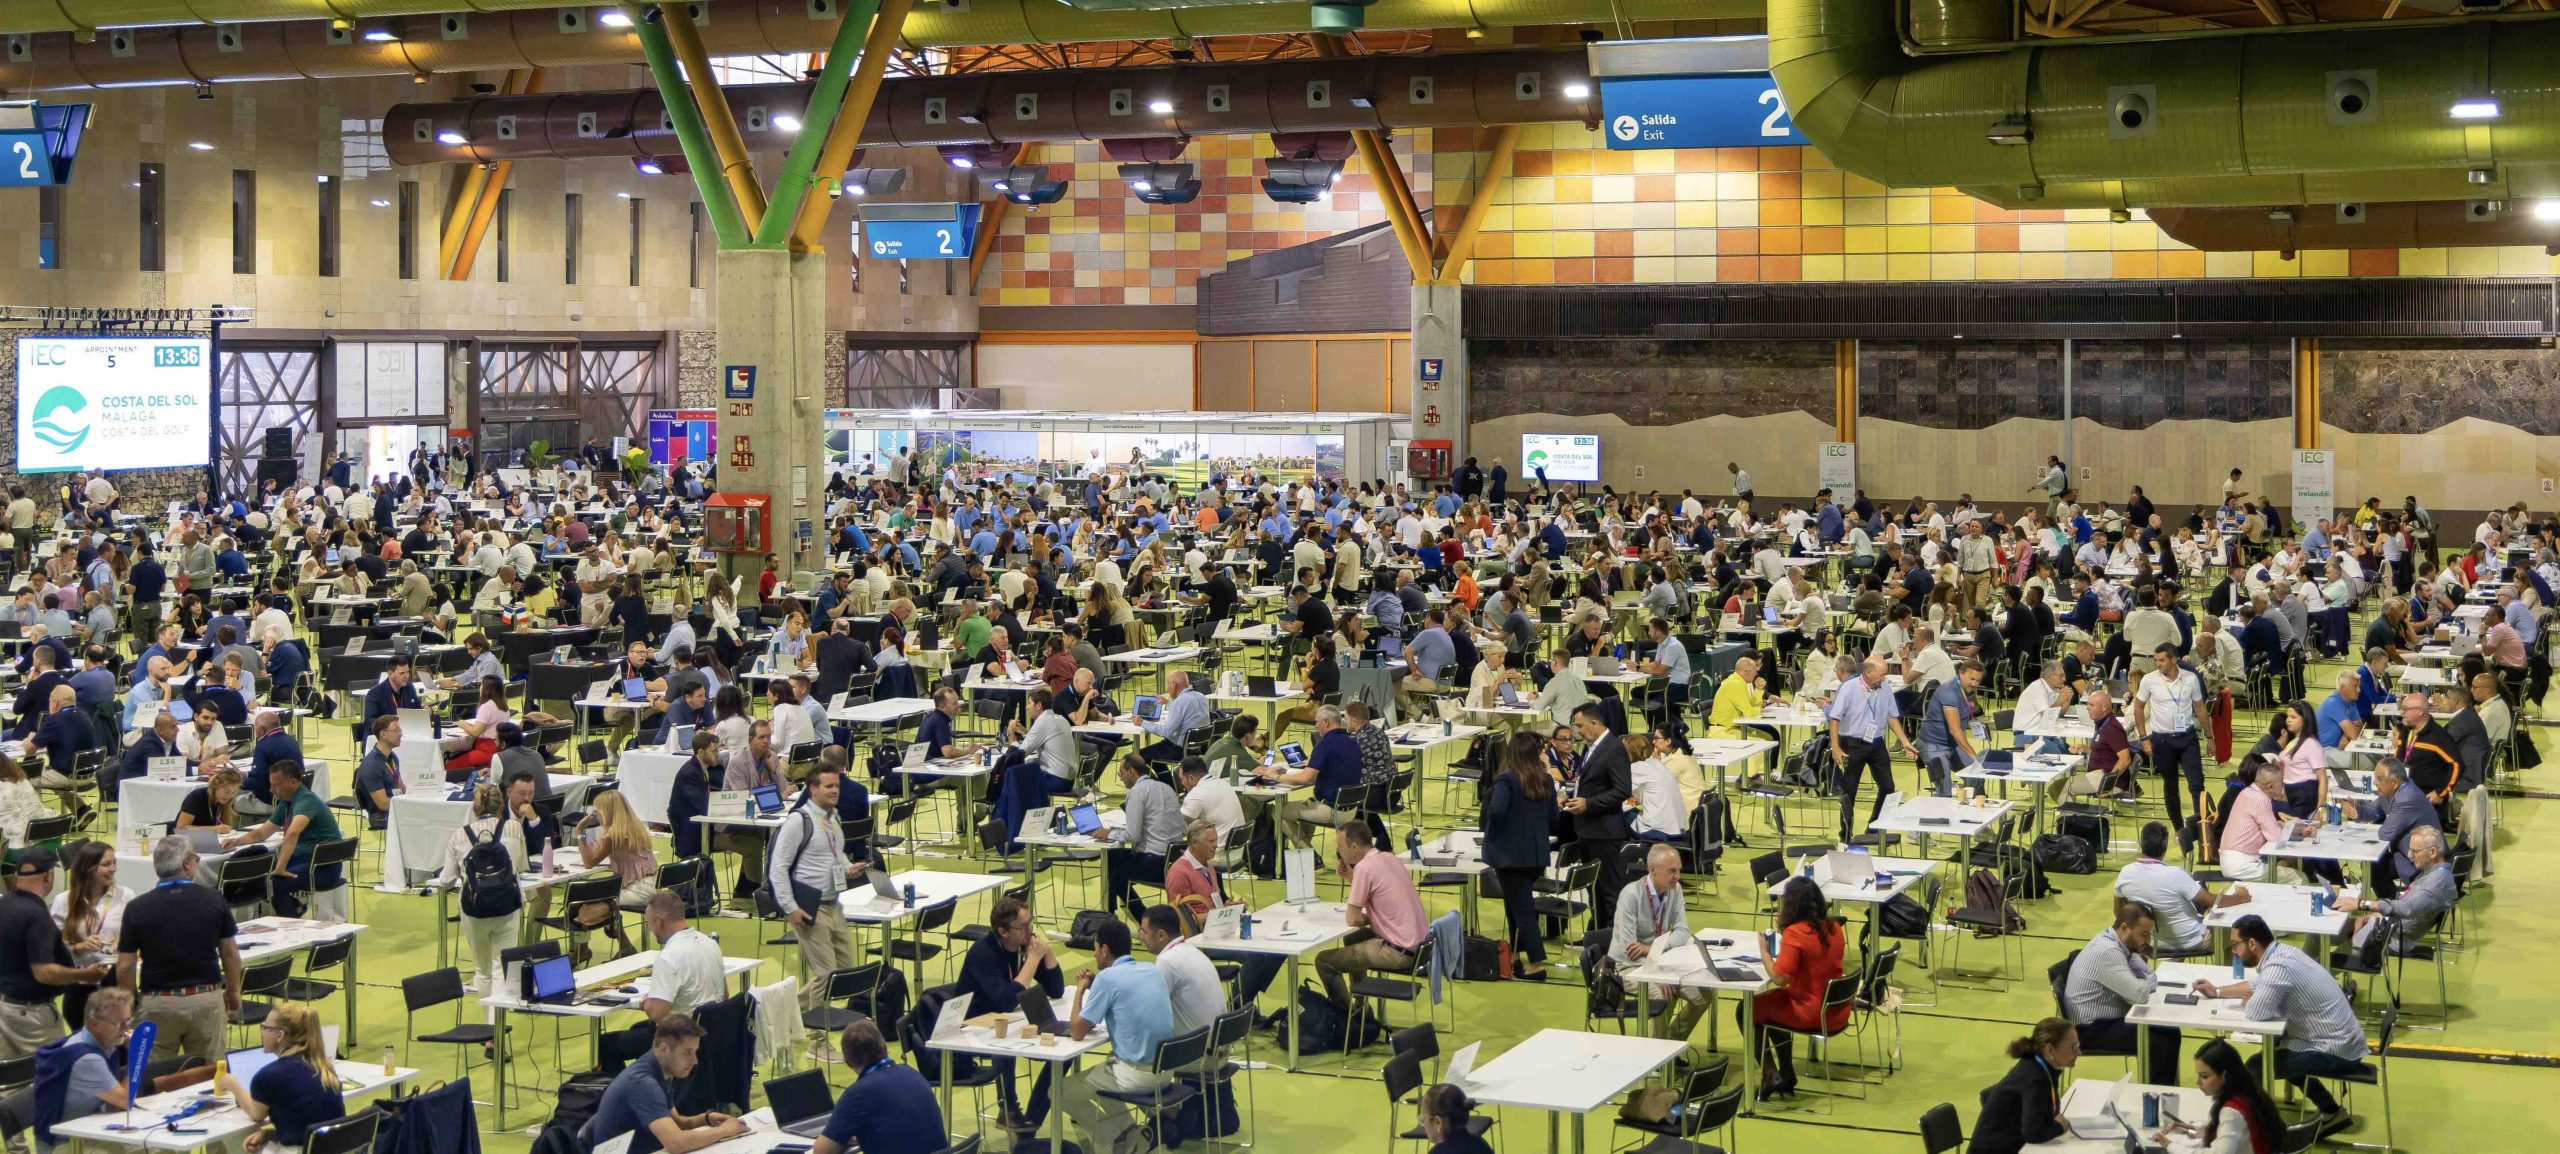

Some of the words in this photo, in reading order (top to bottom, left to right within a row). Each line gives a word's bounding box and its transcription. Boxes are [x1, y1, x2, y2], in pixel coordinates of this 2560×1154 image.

[1641, 114, 1677, 126] Salida
[1758, 89, 1790, 137] 2
[1643, 129, 1664, 141] Exit
[12, 141, 39, 179] 2
[936, 229, 953, 254] 2
[31, 344, 66, 366] IEC
[107, 355, 116, 368] 5
[156, 348, 199, 365] 13:36
[102, 396, 144, 408] COSTA
[148, 395, 171, 407] DEL
[175, 394, 198, 406] SOL
[102, 427, 137, 438] COSTA
[140, 426, 159, 436] DEL
[163, 424, 190, 435] GOLF
[1827, 445, 1847, 456] IEC
[2301, 452, 2324, 463] IEC
[1218, 909, 1233, 918] P17
[132, 1038, 147, 1083] ROBINSON
